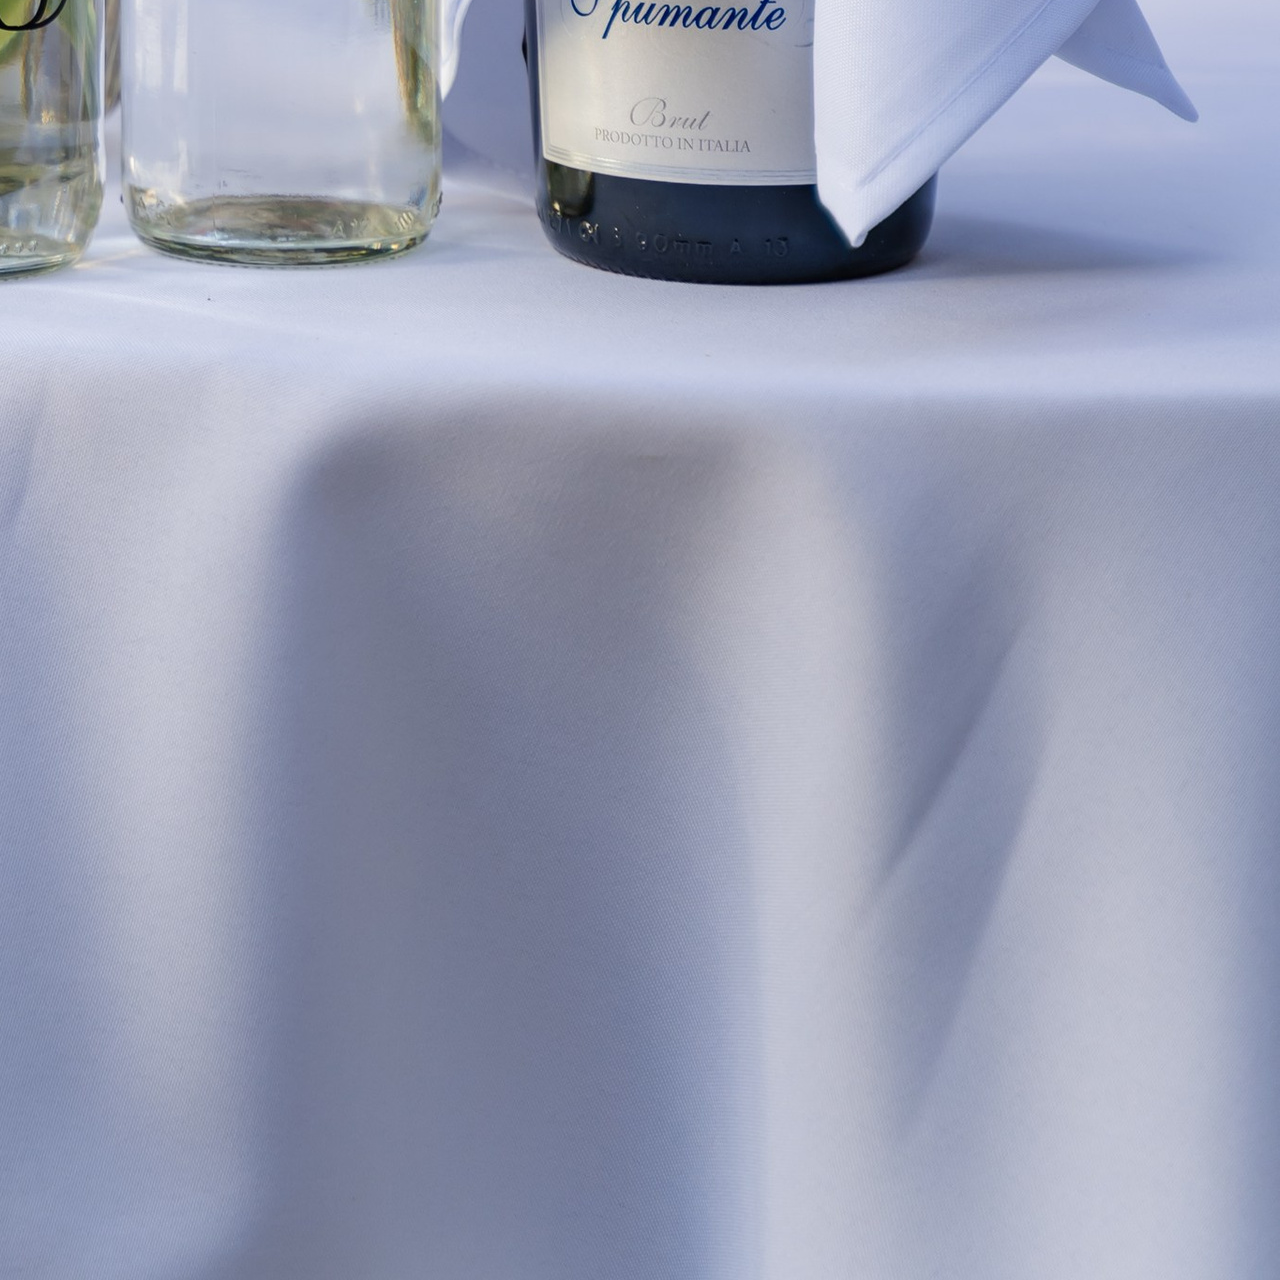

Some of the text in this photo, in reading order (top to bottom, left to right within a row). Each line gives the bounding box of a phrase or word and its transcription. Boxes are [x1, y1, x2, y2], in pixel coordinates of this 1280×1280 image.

[630, 96, 711, 131] Brut
[595, 127, 751, 153] PRODOTTO IN ITALIA
